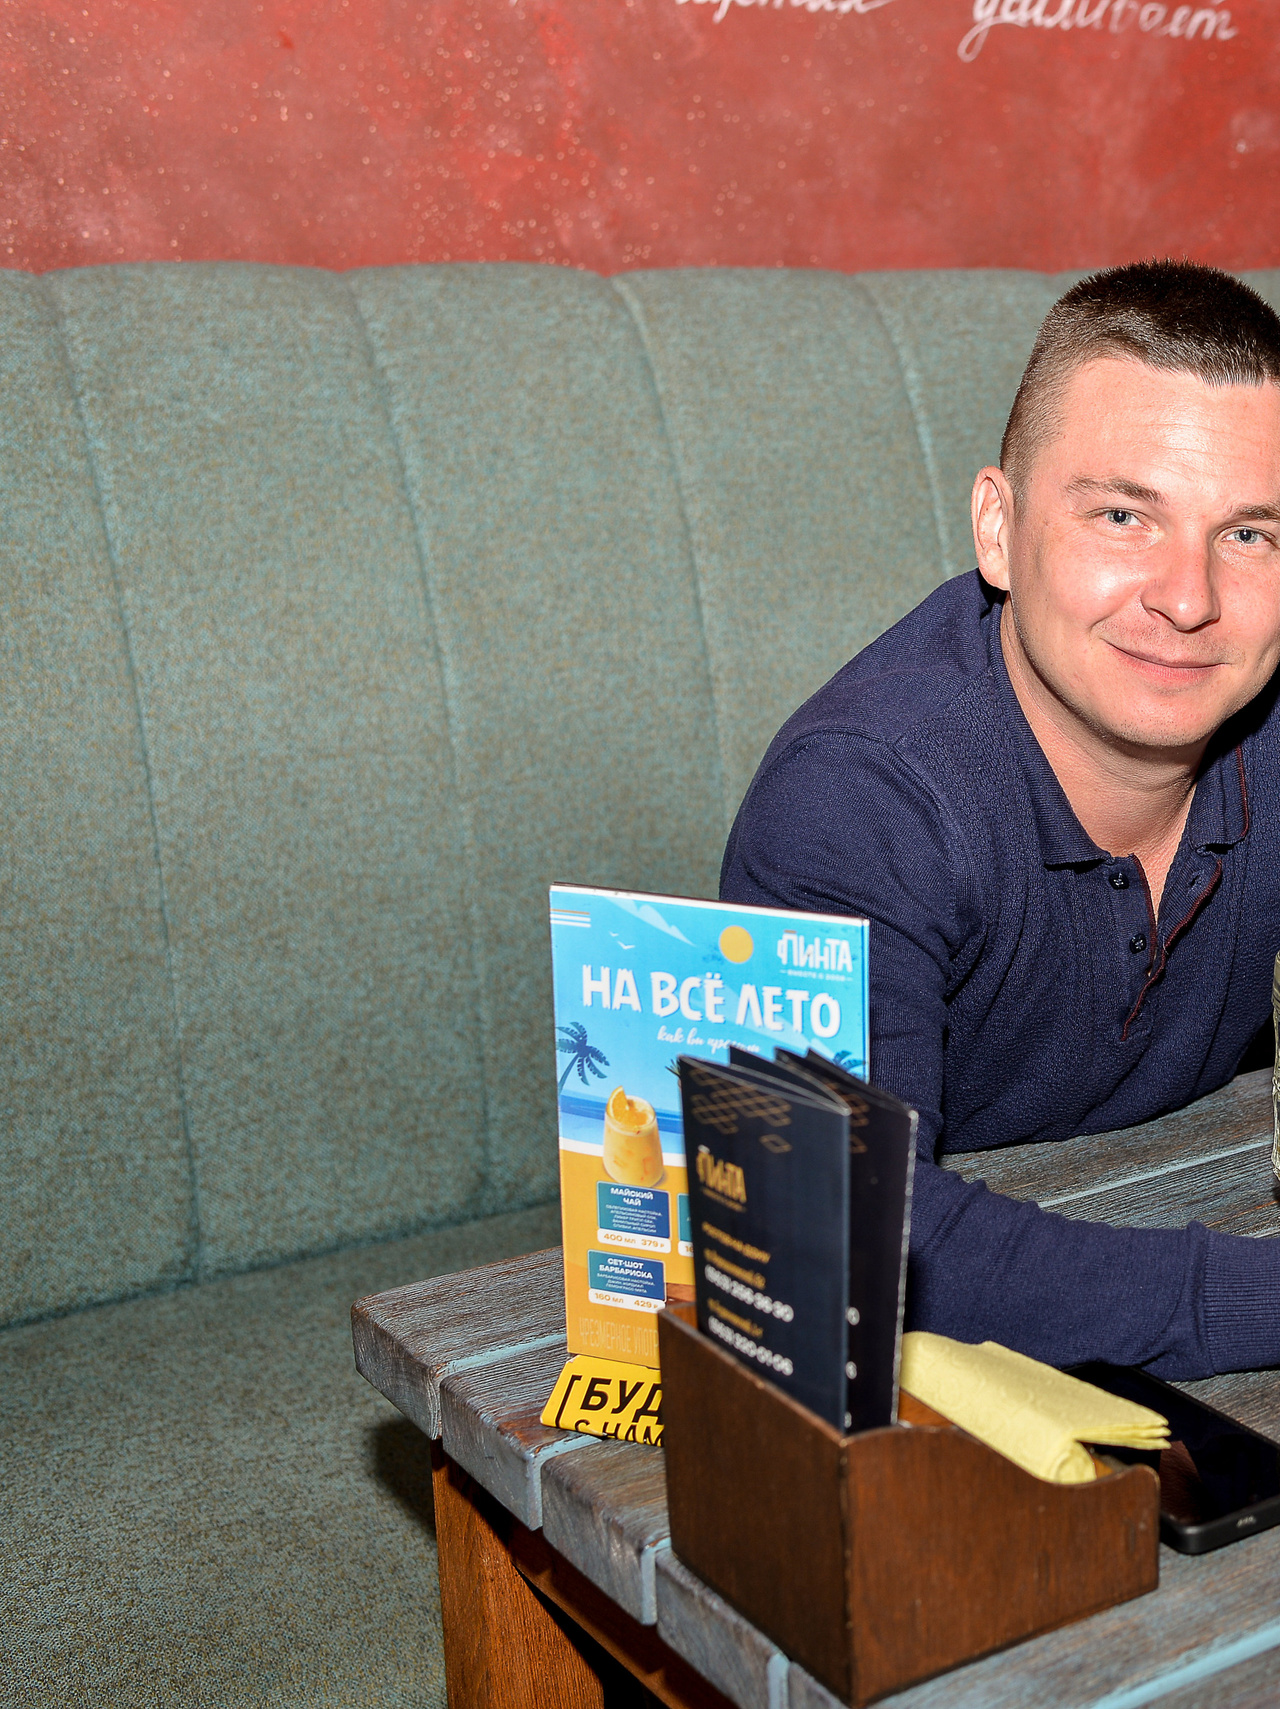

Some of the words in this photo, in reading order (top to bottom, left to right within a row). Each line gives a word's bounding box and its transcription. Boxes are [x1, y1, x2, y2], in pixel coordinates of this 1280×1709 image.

[777, 933, 853, 972] ПИНТА
[582, 964, 642, 1012] НА
[650, 971, 726, 1023] ВСЁ
[737, 984, 841, 1038] ЛЕТО
[610, 1187, 654, 1200] МАЙСКИЙ
[623, 1197, 642, 1206] ЧАЙ
[603, 1233, 622, 1242] 400
[641, 1239, 658, 1248] 379
[599, 1265, 653, 1279] БАРБАРИСКА
[595, 1293, 611, 1301] 160
[634, 1300, 652, 1308] 429
[580, 1317, 632, 1353] ЧРЕЗМЕРНОЕ
